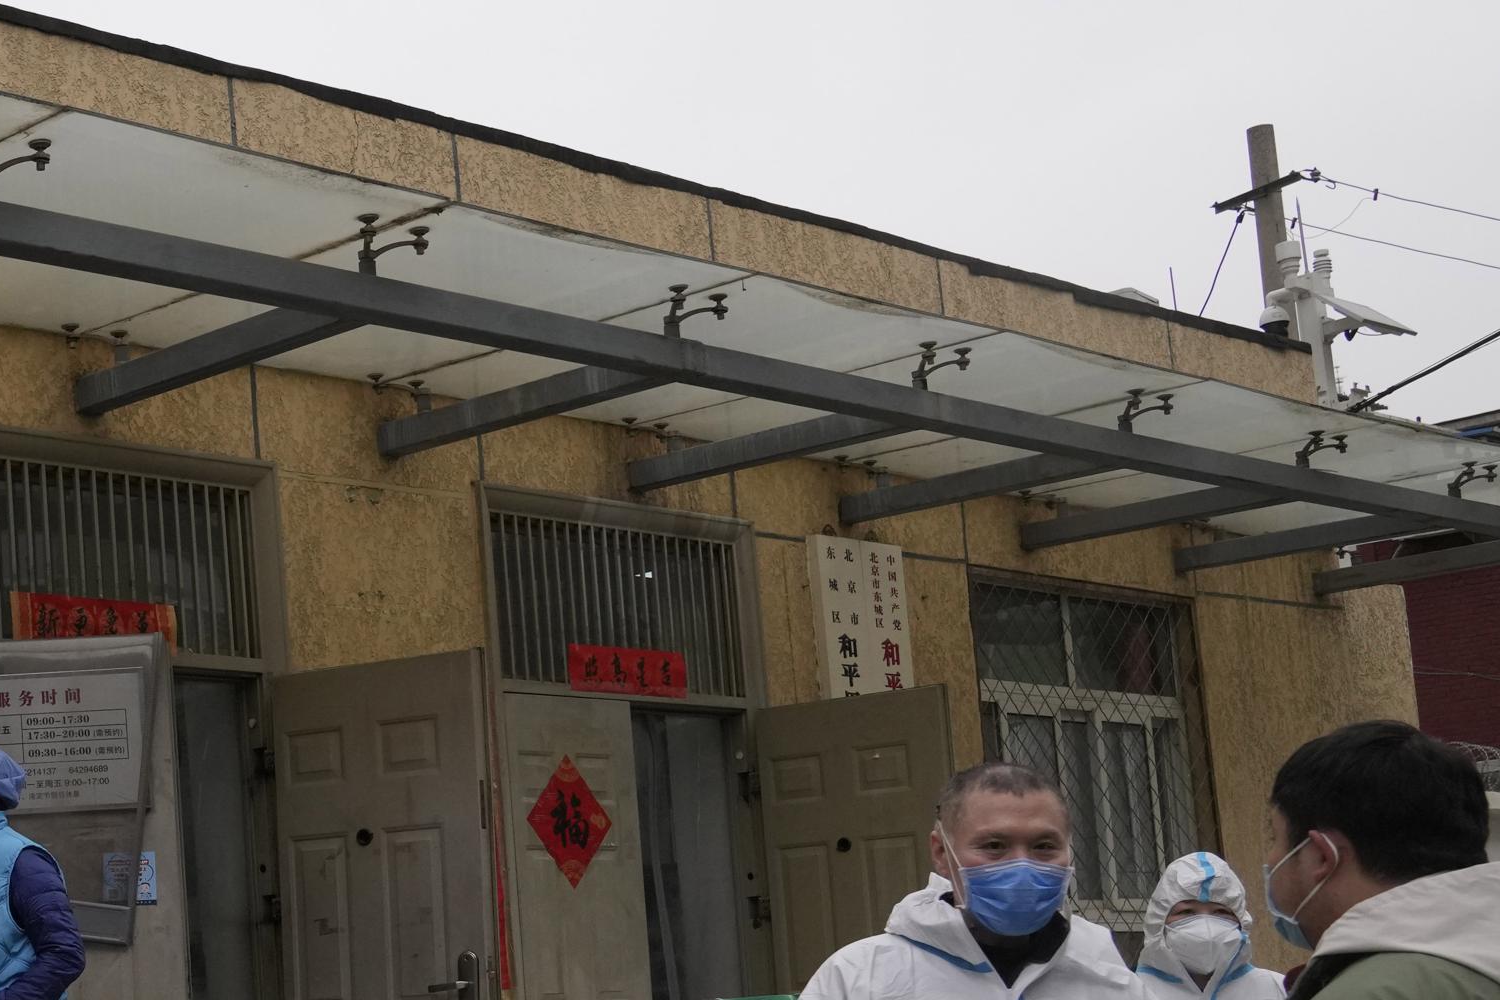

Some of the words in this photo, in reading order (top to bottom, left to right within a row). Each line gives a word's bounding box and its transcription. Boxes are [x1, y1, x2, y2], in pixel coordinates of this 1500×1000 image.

[826, 546, 842, 624] 东城区
[844, 549, 859, 626] 北京市
[869, 552, 884, 629] 北京市东城区
[886, 554, 902, 631] 中国共产党
[837, 633, 860, 697] 和平
[26, 714, 90, 726] 09:00-17:30
[27, 728, 91, 740] 17:30-20:00
[28, 746, 92, 758] 09:30-16:00
[551, 790, 590, 849] 福
